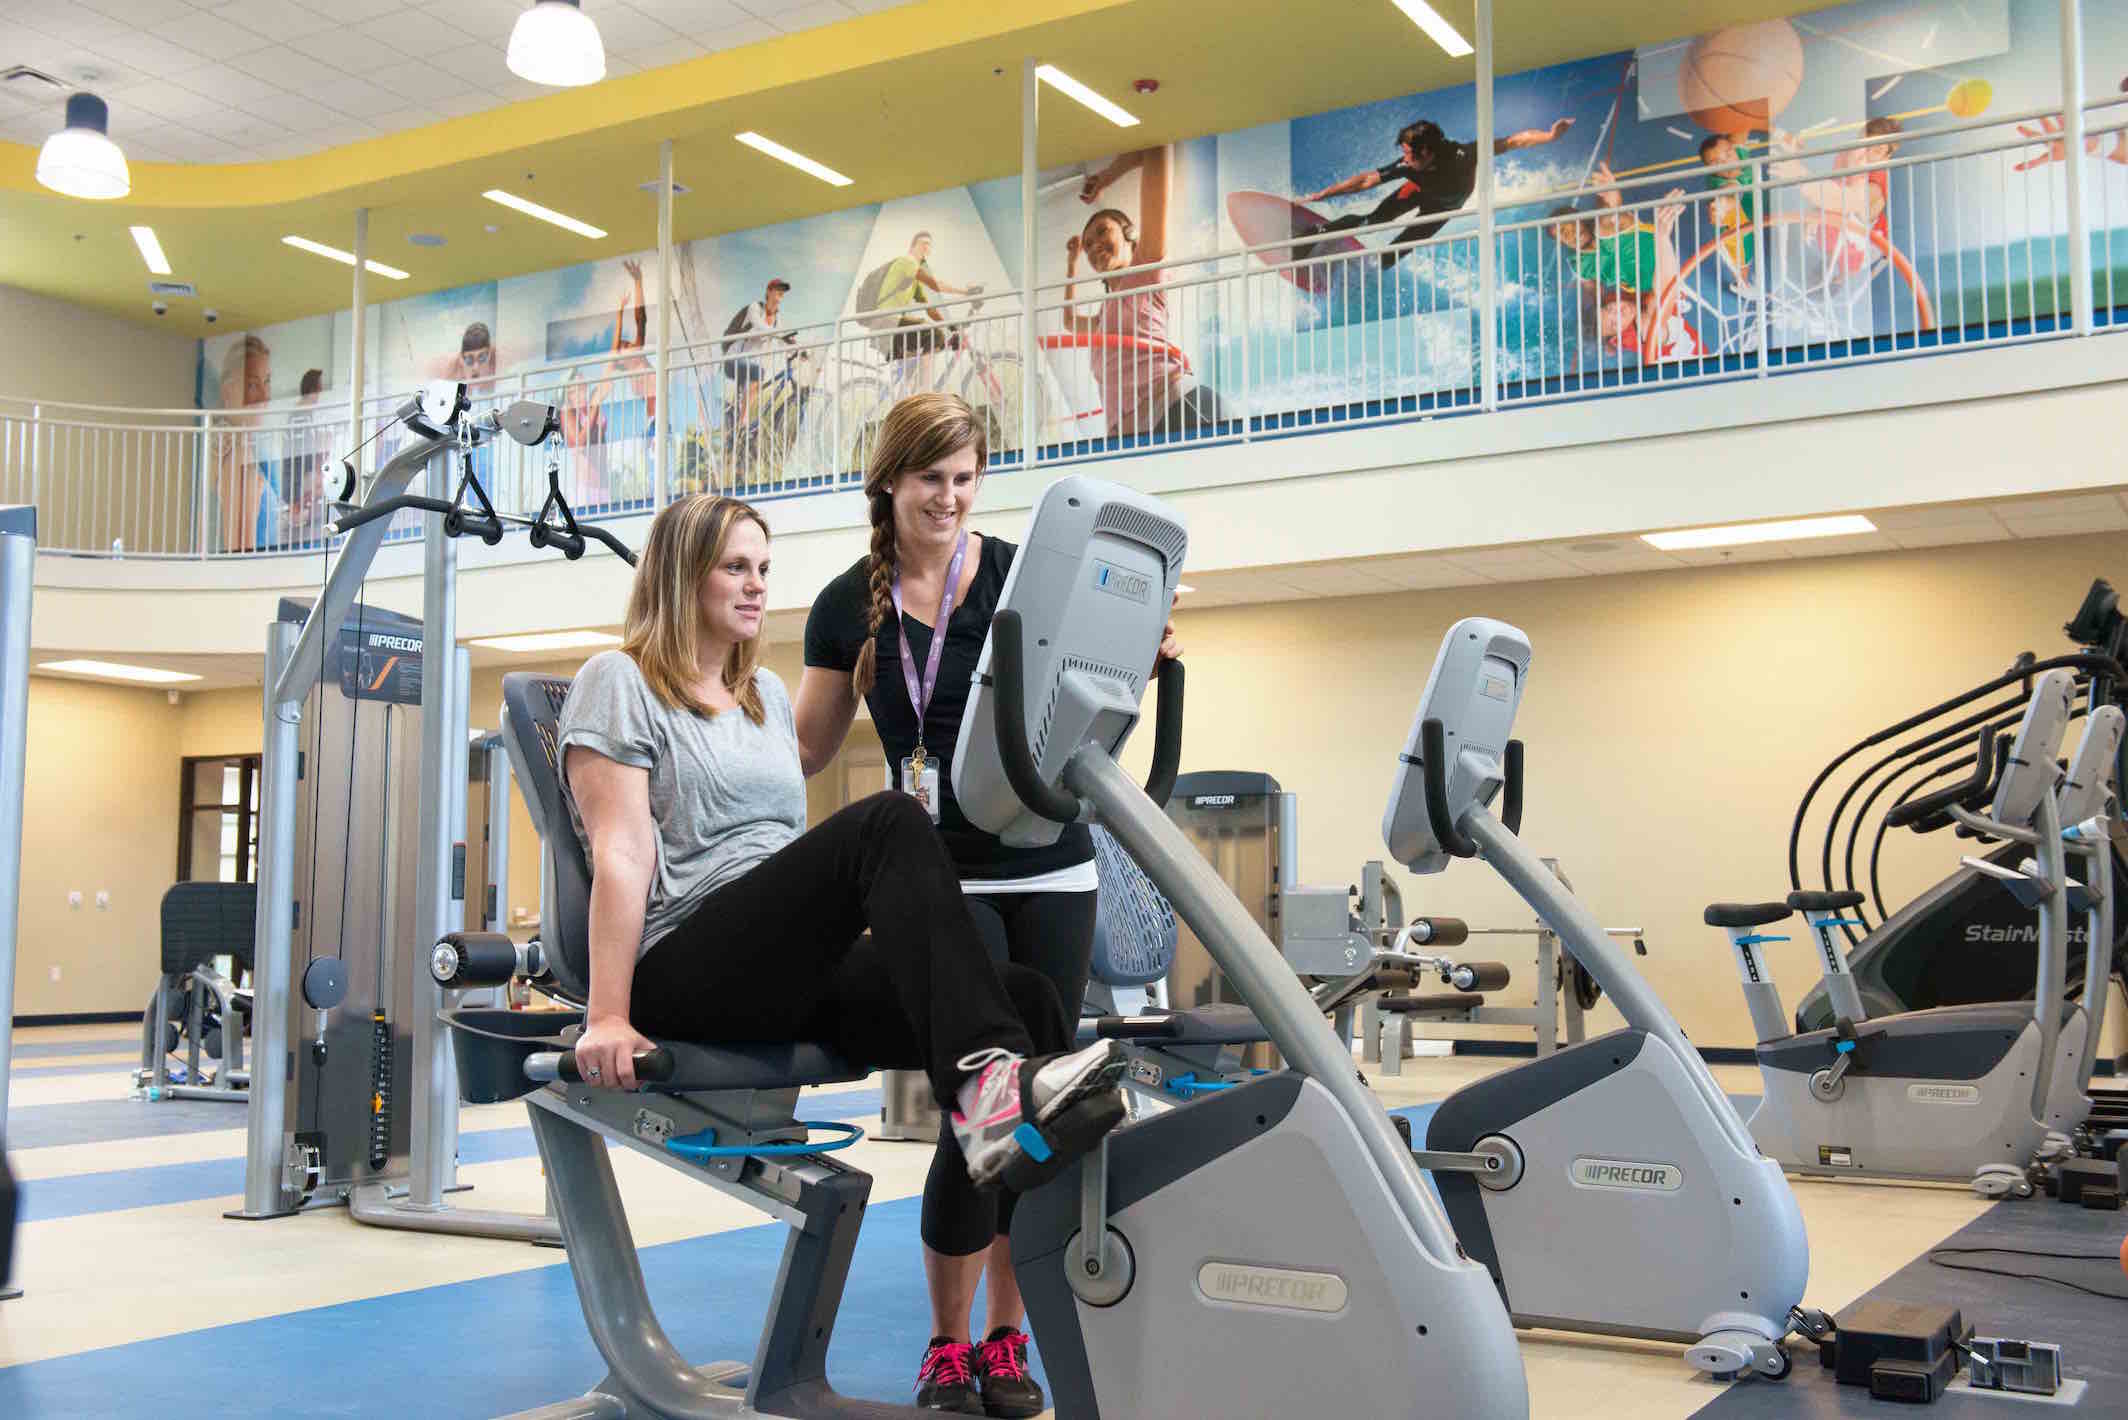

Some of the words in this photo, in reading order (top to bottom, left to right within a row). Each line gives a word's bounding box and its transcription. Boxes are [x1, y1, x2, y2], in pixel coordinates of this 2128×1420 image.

[377, 635, 423, 653] PRECOR
[1199, 795, 1235, 805] PRECOR
[1598, 1165, 1666, 1184] PRECOR
[1231, 1273, 1328, 1300] PRECOR
